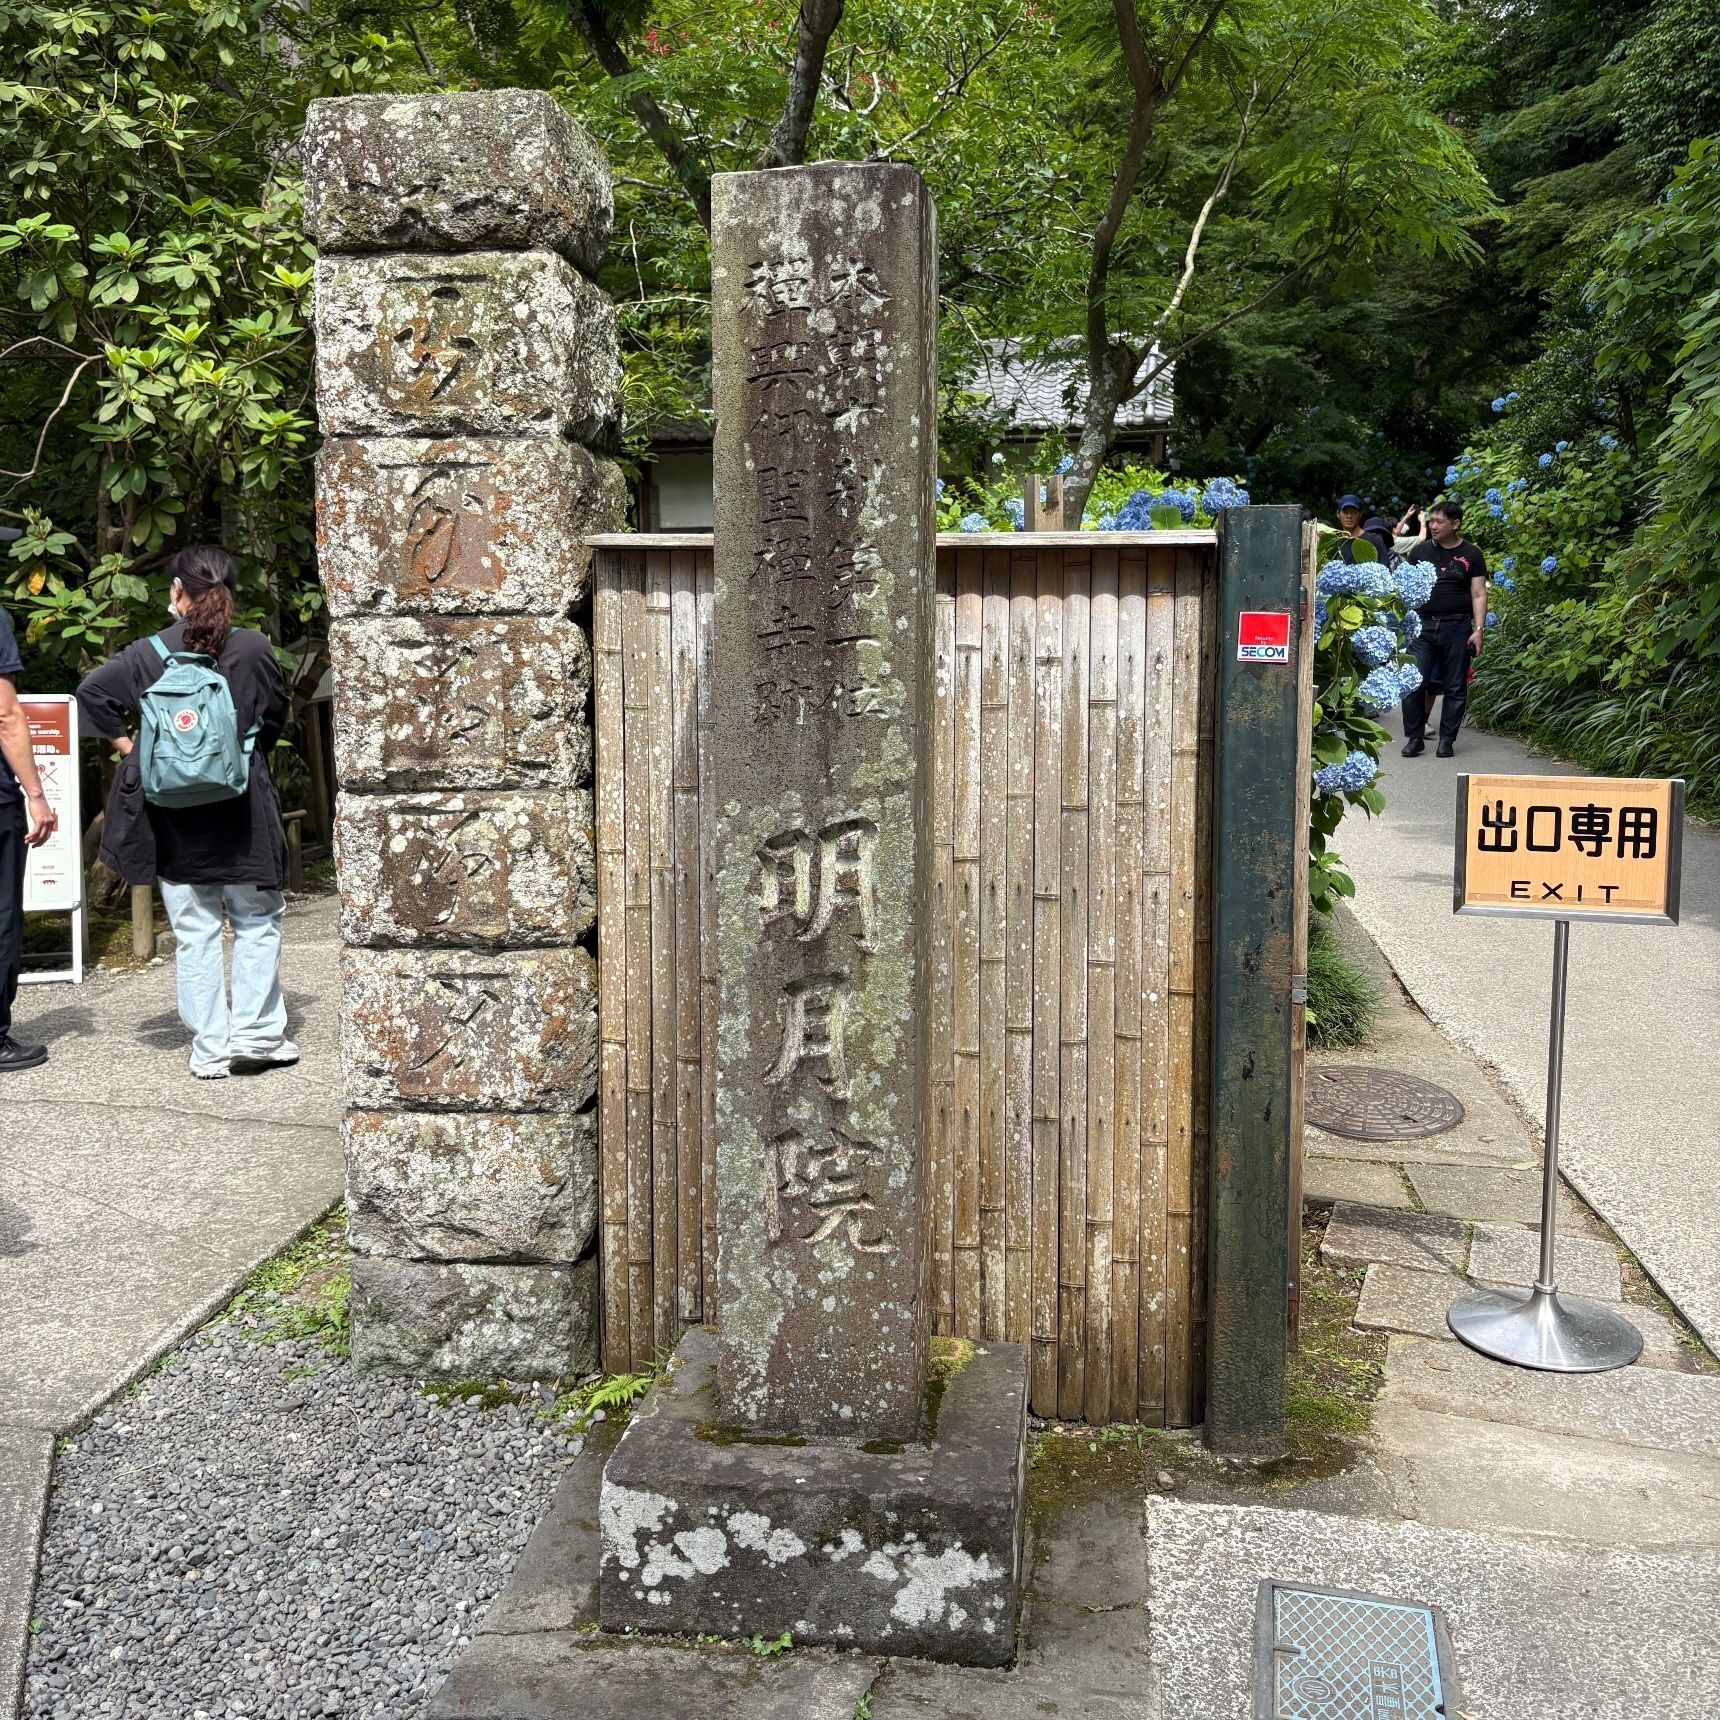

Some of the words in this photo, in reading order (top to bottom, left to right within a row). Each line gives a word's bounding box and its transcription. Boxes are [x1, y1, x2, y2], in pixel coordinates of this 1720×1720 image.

[1241, 646, 1285, 658] SECOM
[1477, 799, 1658, 860] 出口専用
[1510, 880, 1620, 904] EXIT
[755, 816, 896, 1254] 明月院
